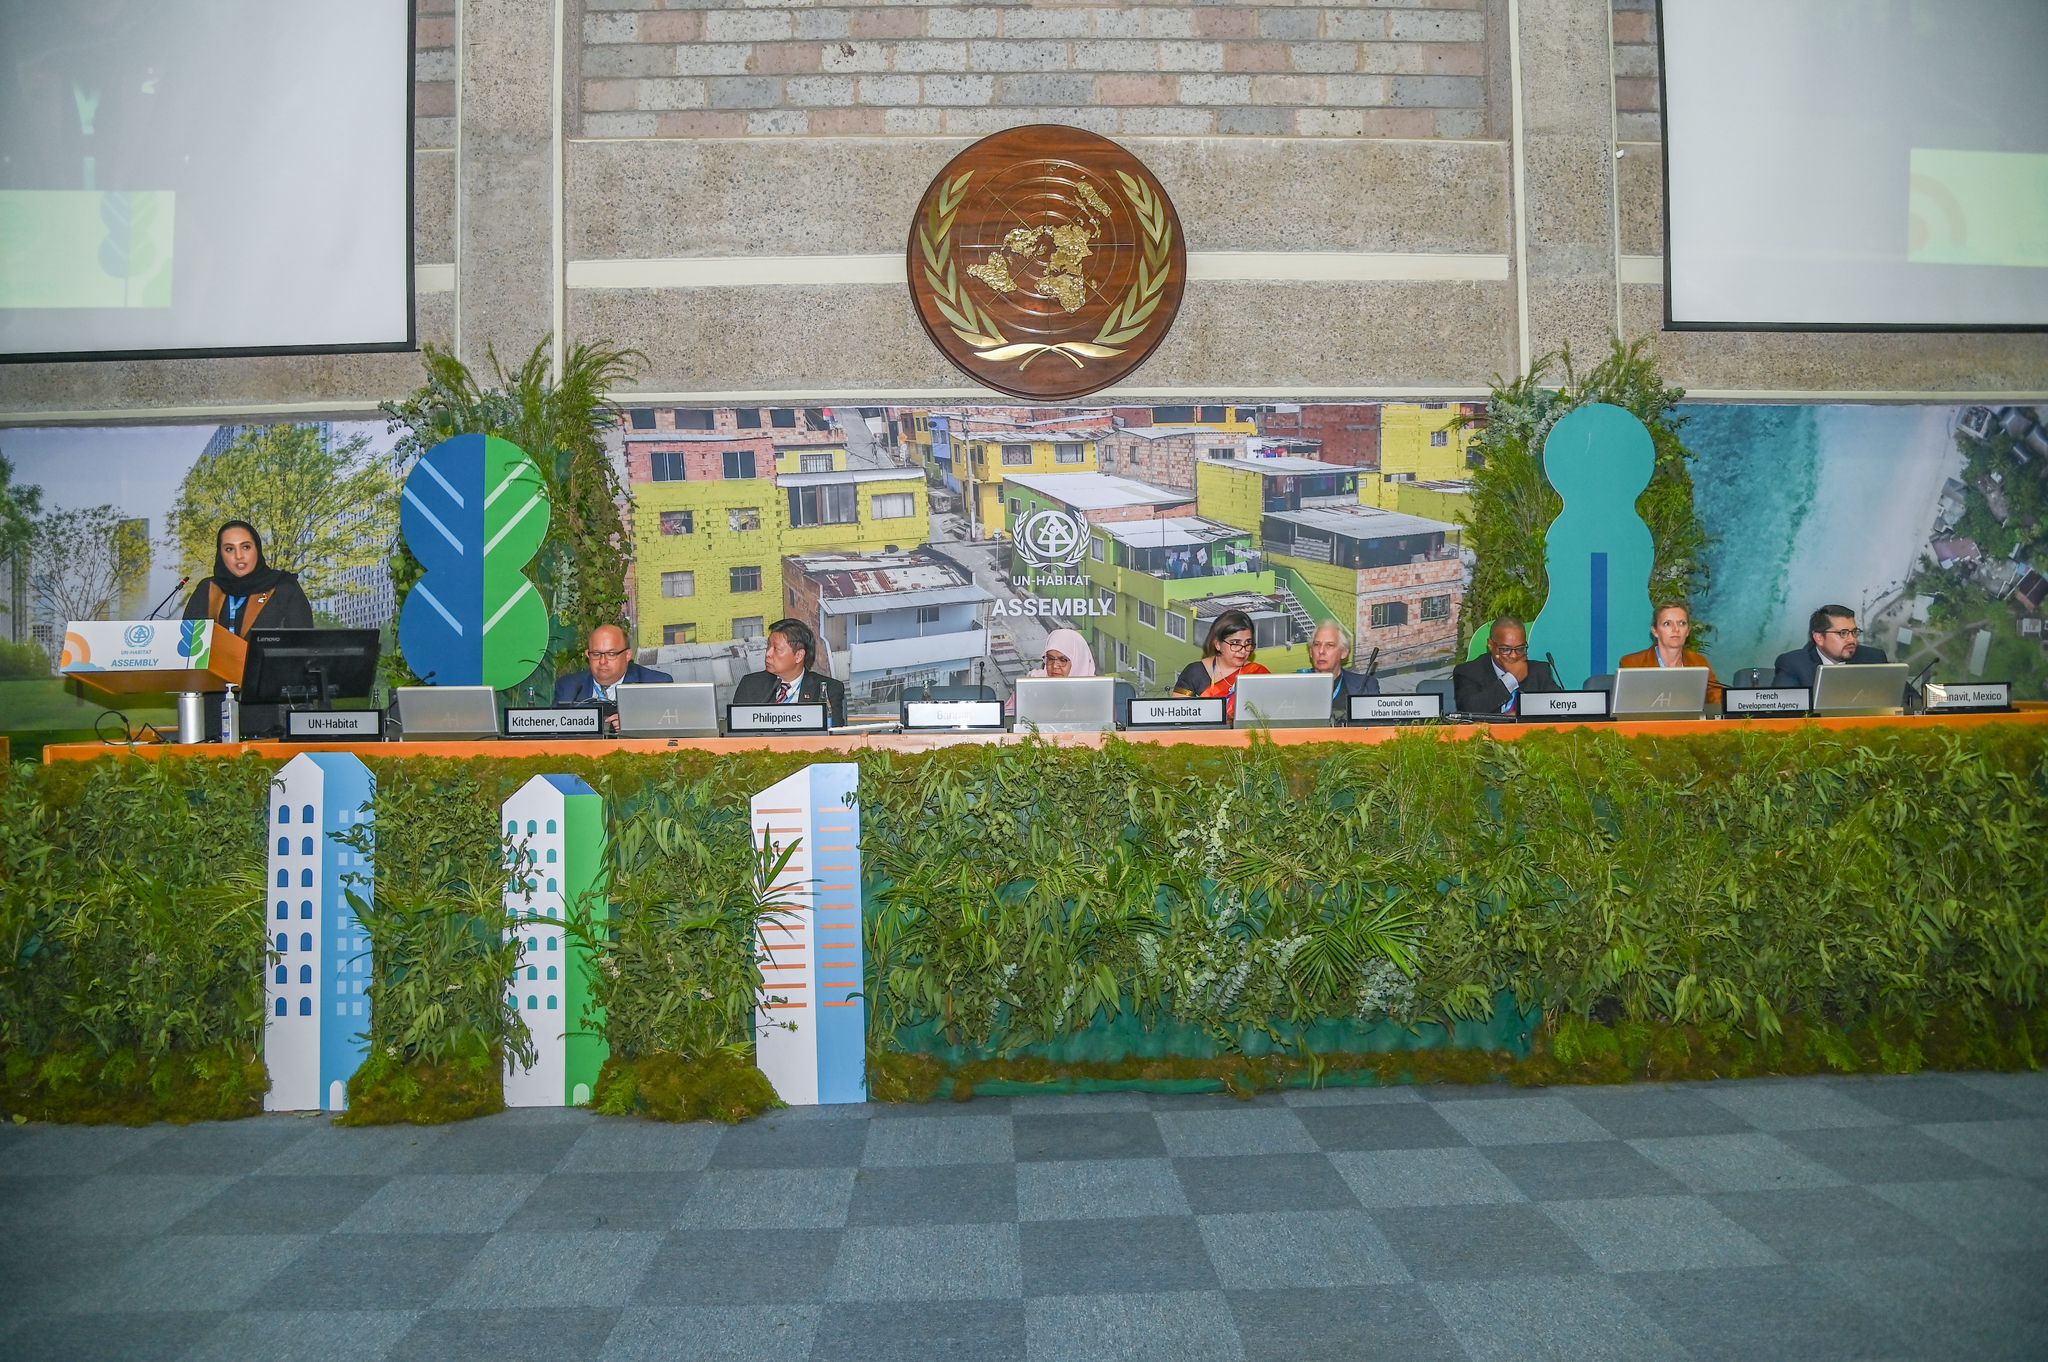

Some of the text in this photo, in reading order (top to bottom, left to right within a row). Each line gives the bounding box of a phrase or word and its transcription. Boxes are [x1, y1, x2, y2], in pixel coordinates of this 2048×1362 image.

[1012, 575, 1091, 586] UN-HABITAT
[991, 598, 1113, 616] ASSEMBLY
[111, 659, 159, 667] ASSEMBLY
[1755, 692, 1778, 700] French
[1973, 691, 2002, 701] Mexico
[1377, 699, 1403, 707] Council
[1550, 699, 1577, 710] Kenya
[1738, 702, 1799, 710] Development Agency
[1150, 706, 1202, 717] UN-Habitat
[1371, 709, 1390, 717] Urban
[512, 715, 595, 727] Kitchener, Canada
[752, 711, 802, 724] Philippines
[308, 718, 358, 729] UN-Habitat
